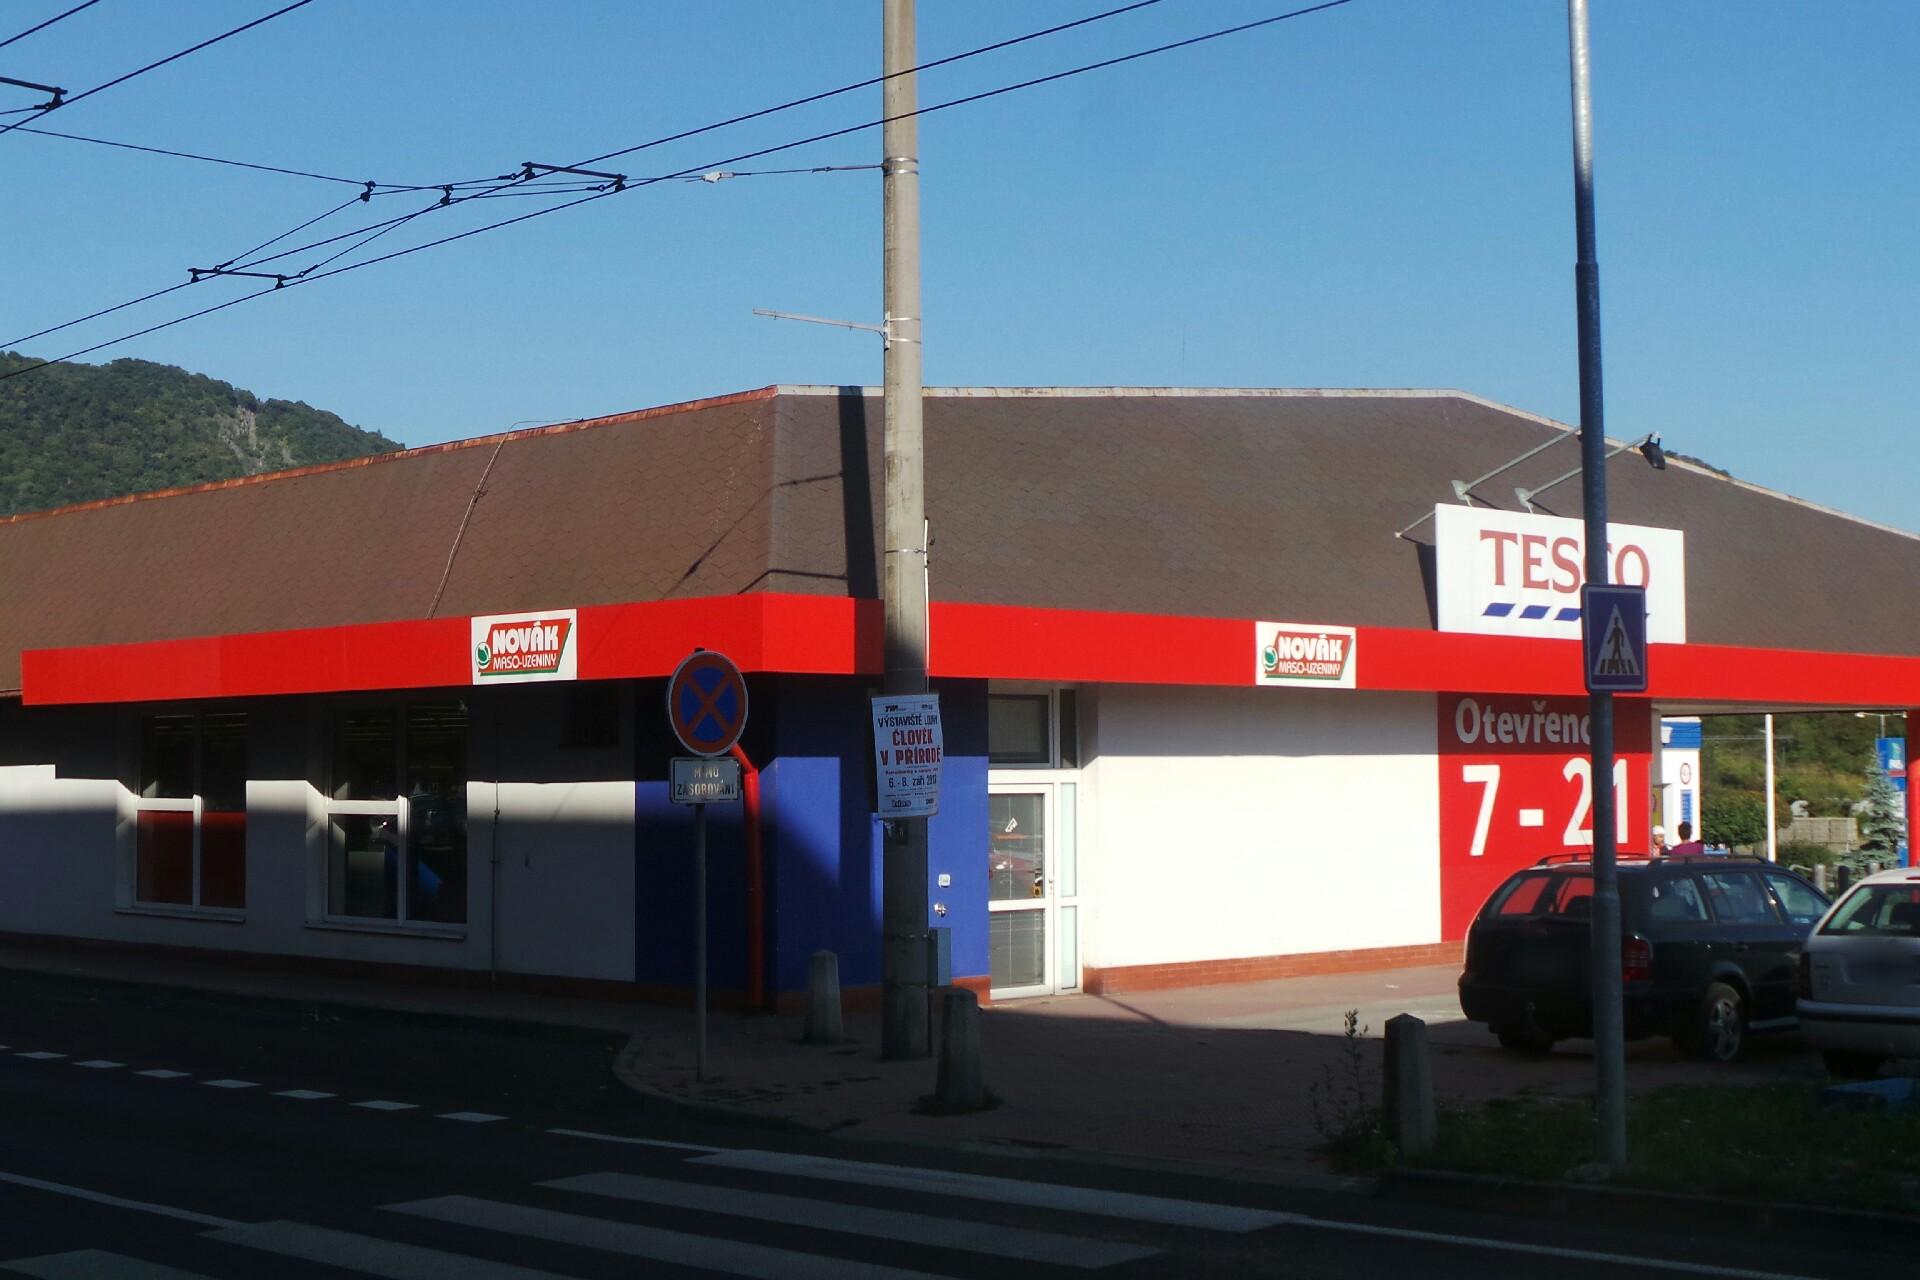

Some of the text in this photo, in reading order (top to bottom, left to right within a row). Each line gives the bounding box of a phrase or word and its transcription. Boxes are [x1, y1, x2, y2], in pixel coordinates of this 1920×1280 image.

[1479, 529, 1650, 594] TESO
[493, 653, 557, 670] MASO-UZENINY
[1278, 661, 1341, 675] MASO-UZENINY
[892, 728, 933, 746] ČLOVĚK
[880, 750, 889, 766] V
[1462, 764, 1501, 857] 7
[1562, 757, 1629, 847] 21
